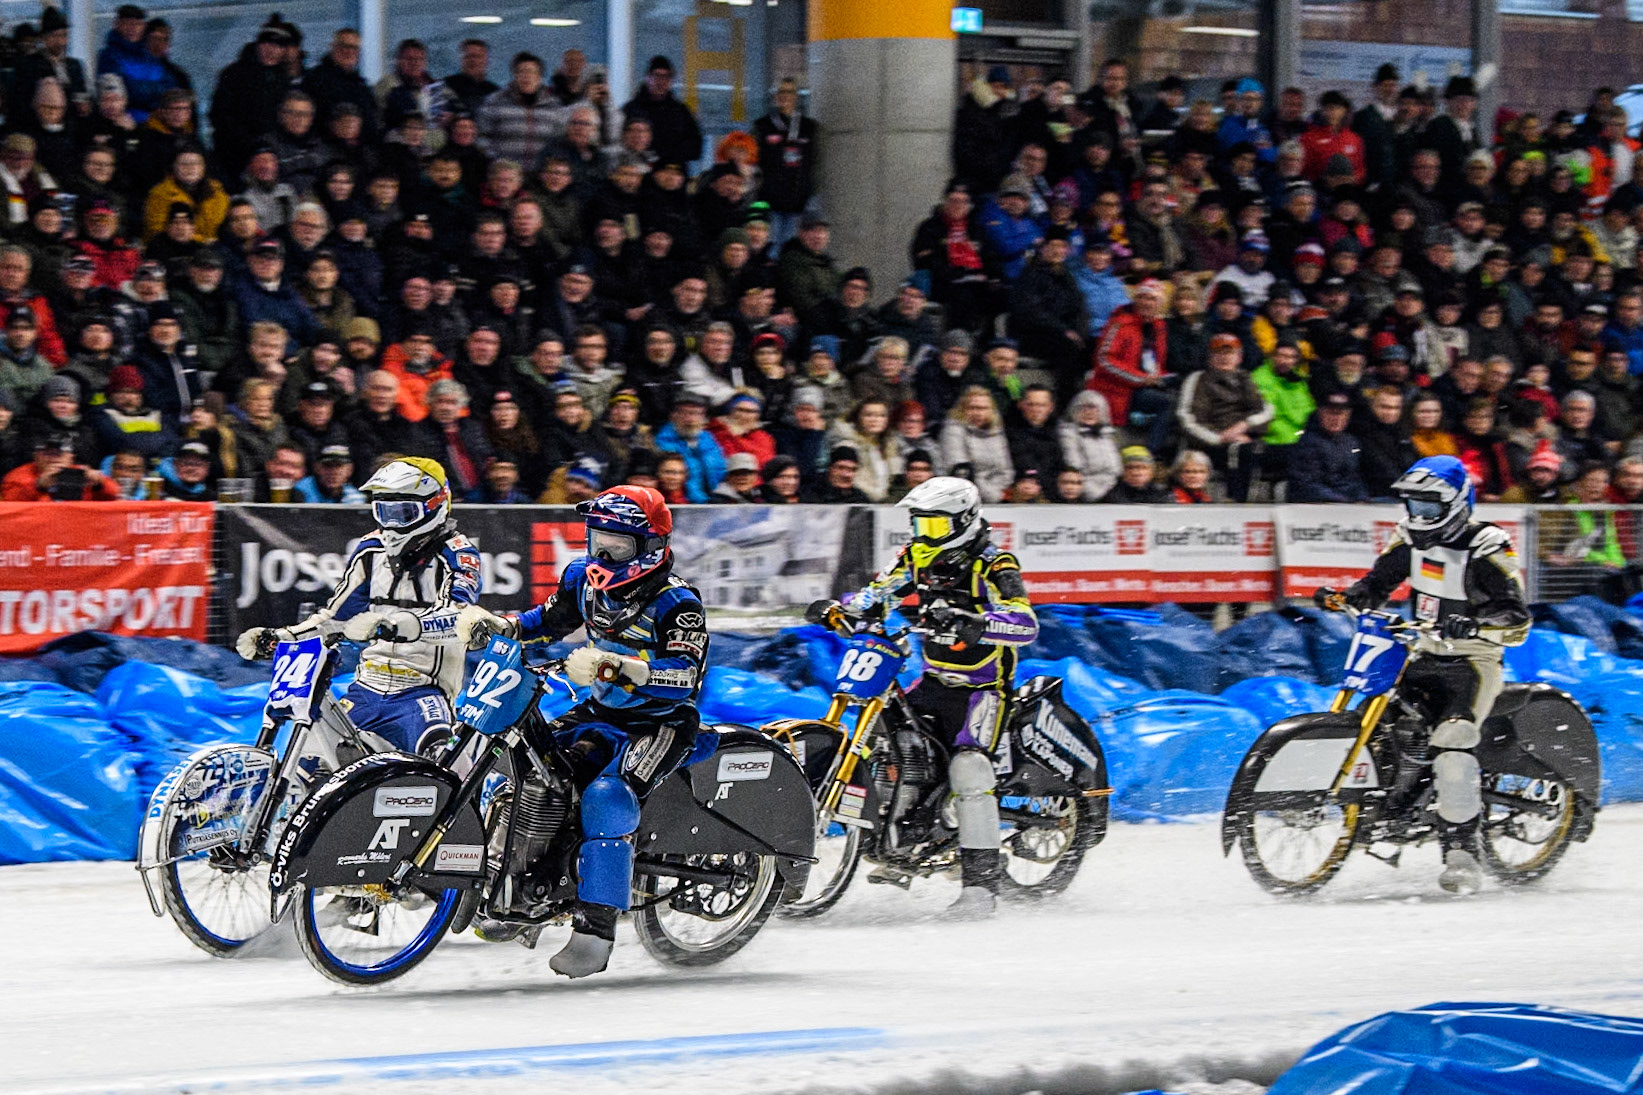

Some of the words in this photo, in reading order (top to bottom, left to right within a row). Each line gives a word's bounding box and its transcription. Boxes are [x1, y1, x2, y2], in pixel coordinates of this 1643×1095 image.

[237, 540, 352, 608] Jose
[271, 653, 317, 692] 24
[836, 648, 884, 682] 88
[1343, 631, 1396, 674] 17
[460, 703, 485, 722] FIM
[270, 830, 297, 888] Ö-viks
